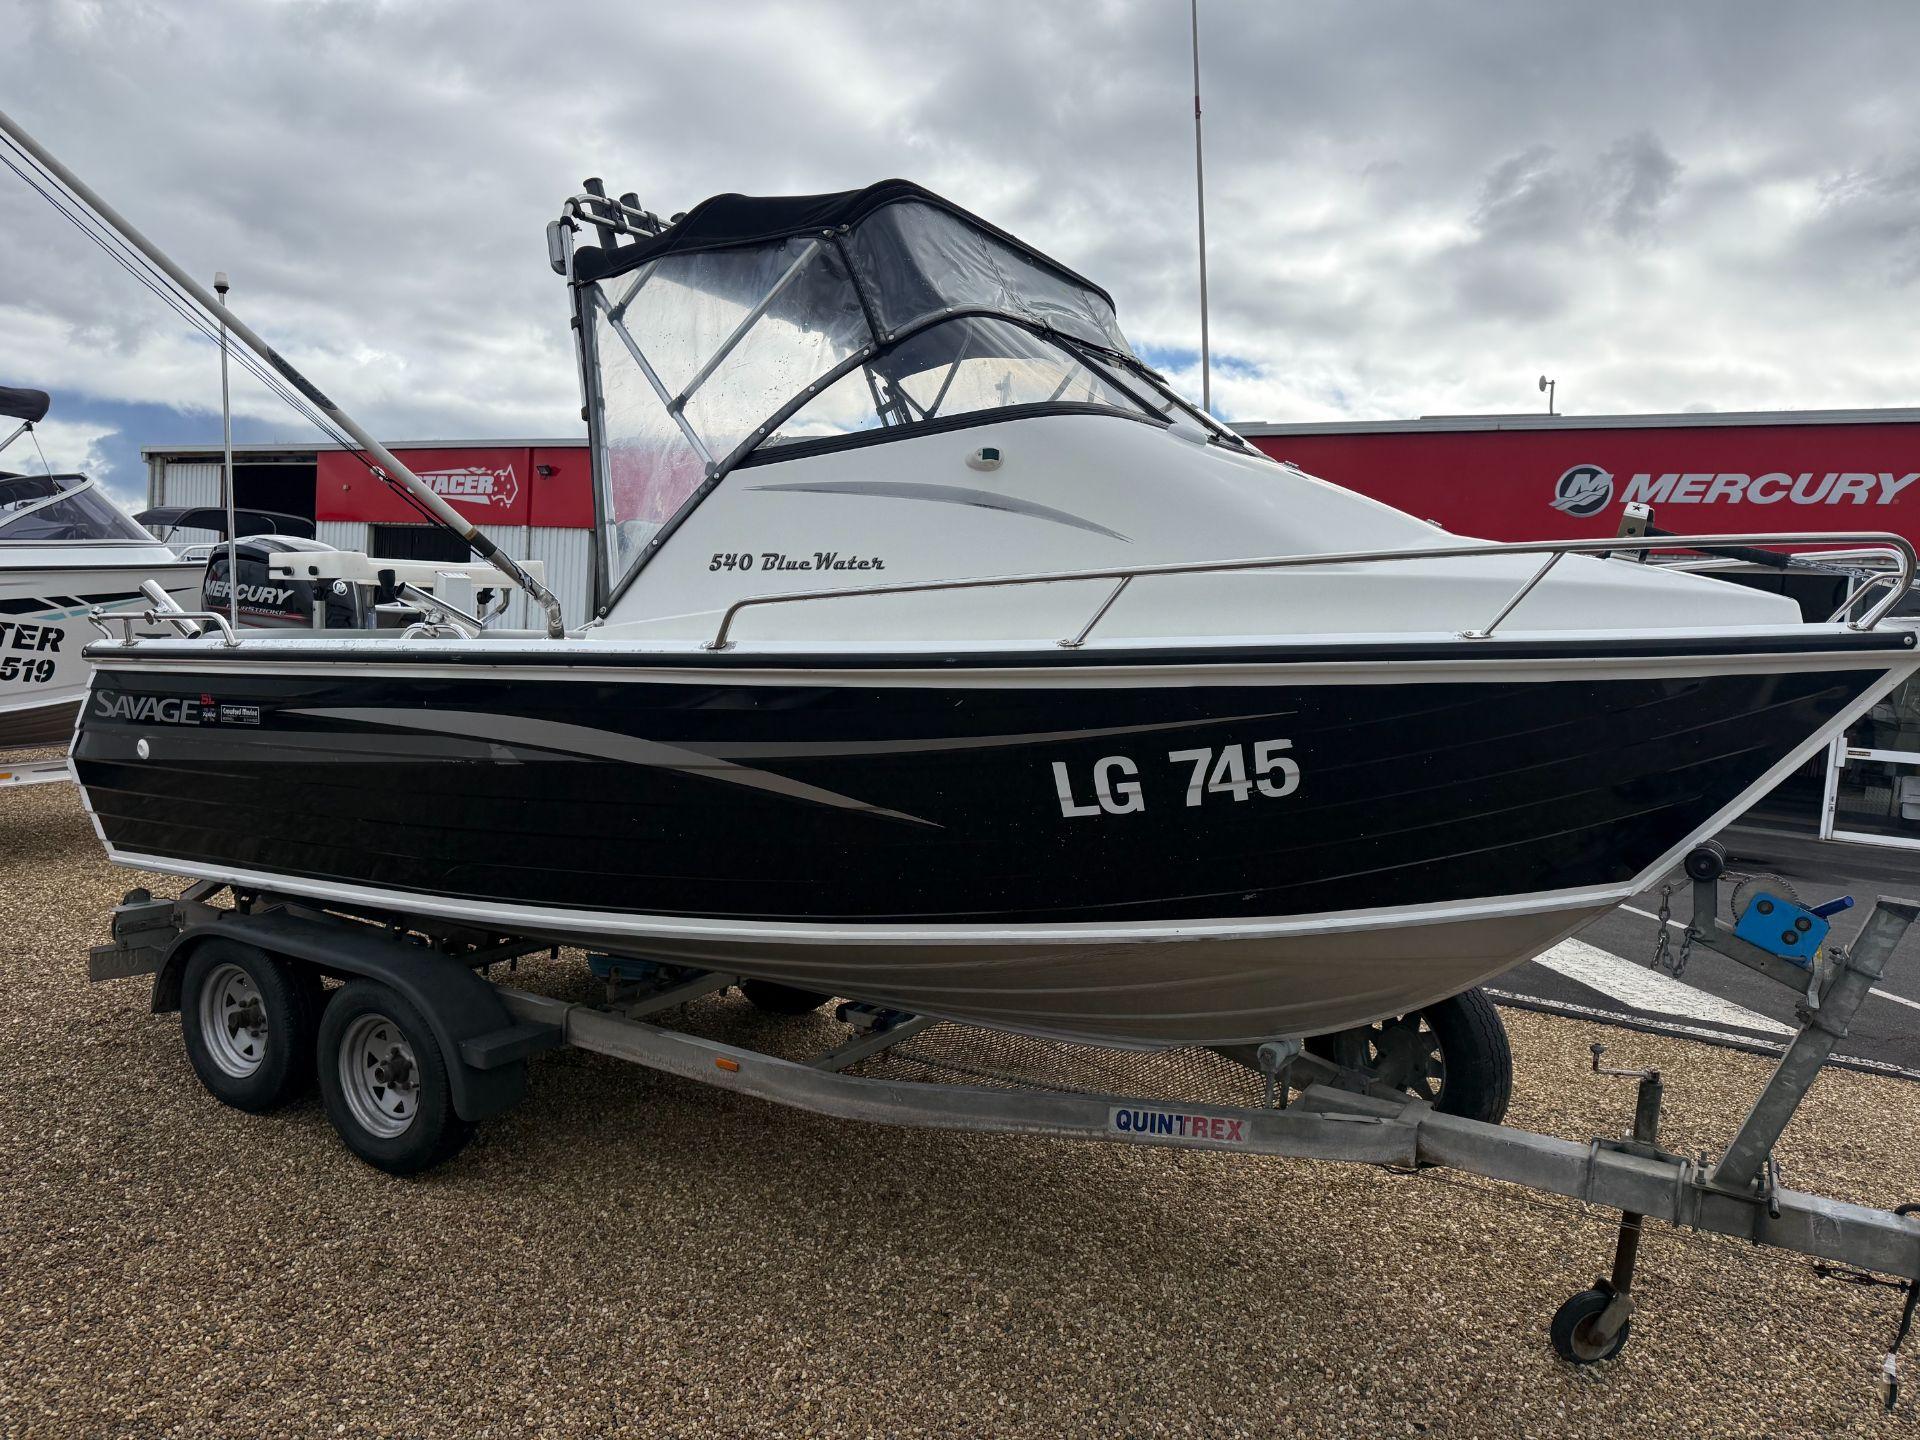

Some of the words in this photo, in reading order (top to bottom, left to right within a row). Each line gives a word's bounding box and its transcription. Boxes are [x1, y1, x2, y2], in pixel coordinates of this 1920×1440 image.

[407, 475, 494, 494] TACER
[1619, 472, 1920, 505] MERCURY
[709, 553, 753, 571] 540
[205, 580, 295, 605] MERCURY
[0, 621, 65, 652] TER
[0, 656, 56, 683] 519
[94, 689, 200, 725] SAVAGE
[1052, 755, 1145, 817] LG
[1169, 739, 1300, 807] 745
[1116, 1109, 1245, 1141] QUINTREX
